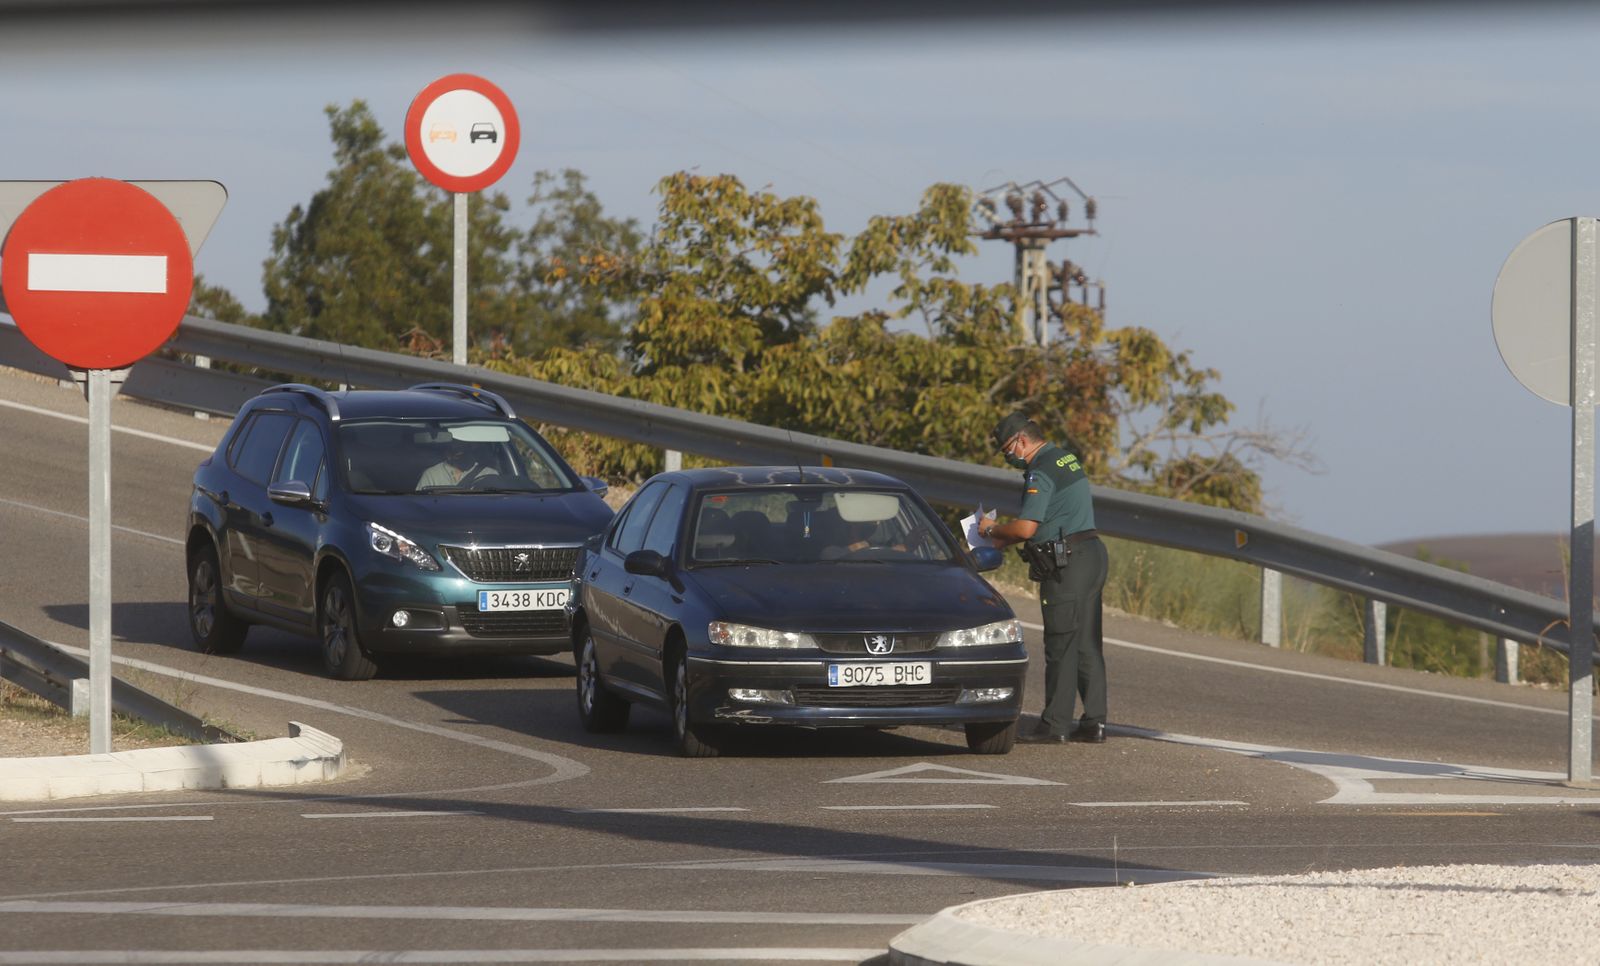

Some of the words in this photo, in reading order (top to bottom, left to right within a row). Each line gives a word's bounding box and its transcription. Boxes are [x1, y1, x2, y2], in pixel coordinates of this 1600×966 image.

[491, 593, 531, 608] 3438
[536, 592, 566, 607] KDC
[844, 666, 884, 683] 9075
[894, 665, 924, 682] BHC
